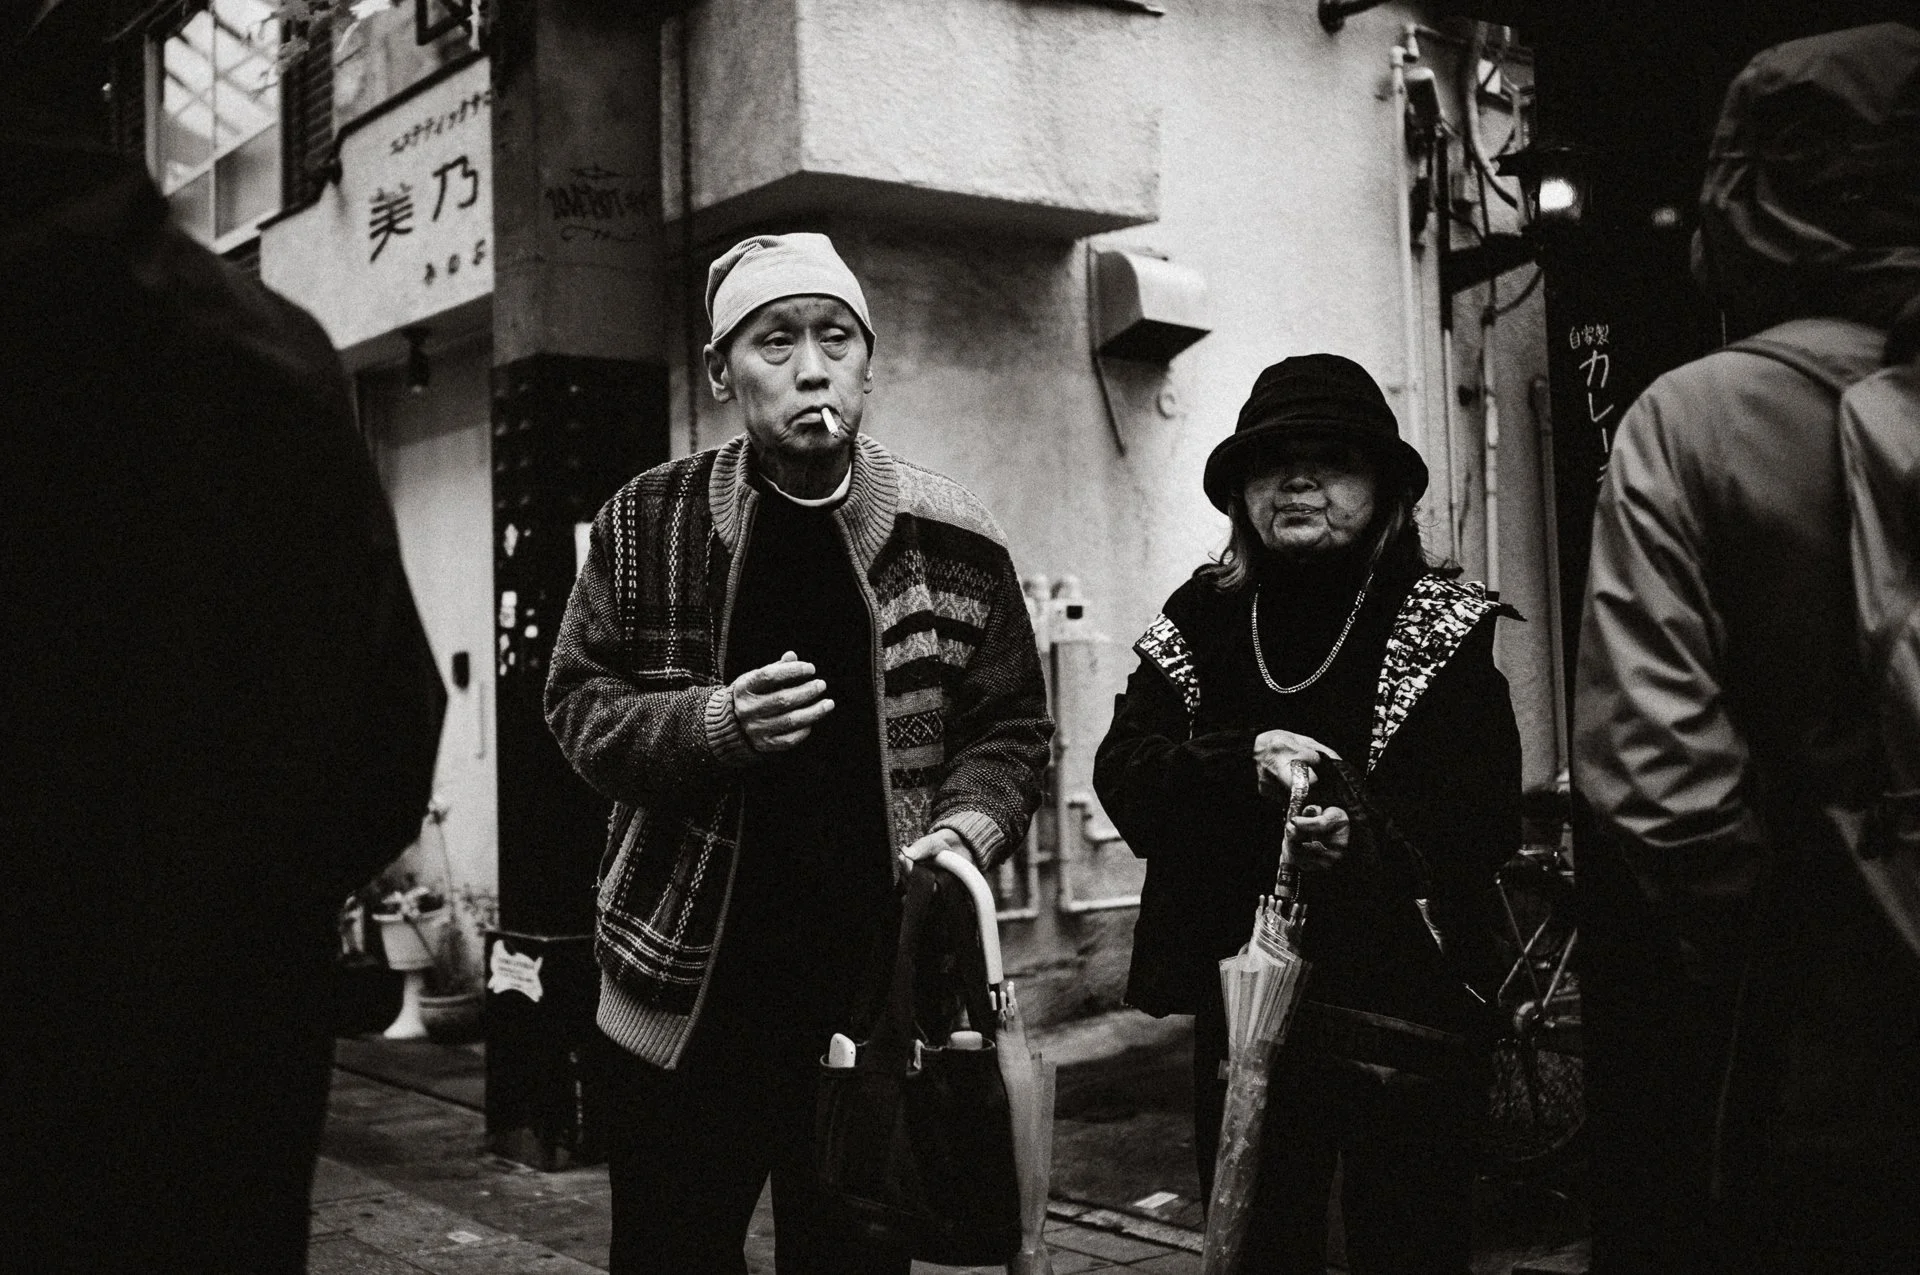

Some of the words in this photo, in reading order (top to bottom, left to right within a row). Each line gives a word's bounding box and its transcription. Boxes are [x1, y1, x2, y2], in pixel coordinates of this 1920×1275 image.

[369, 155, 478, 263] 美乃
[1570, 323, 1610, 349] 自家製
